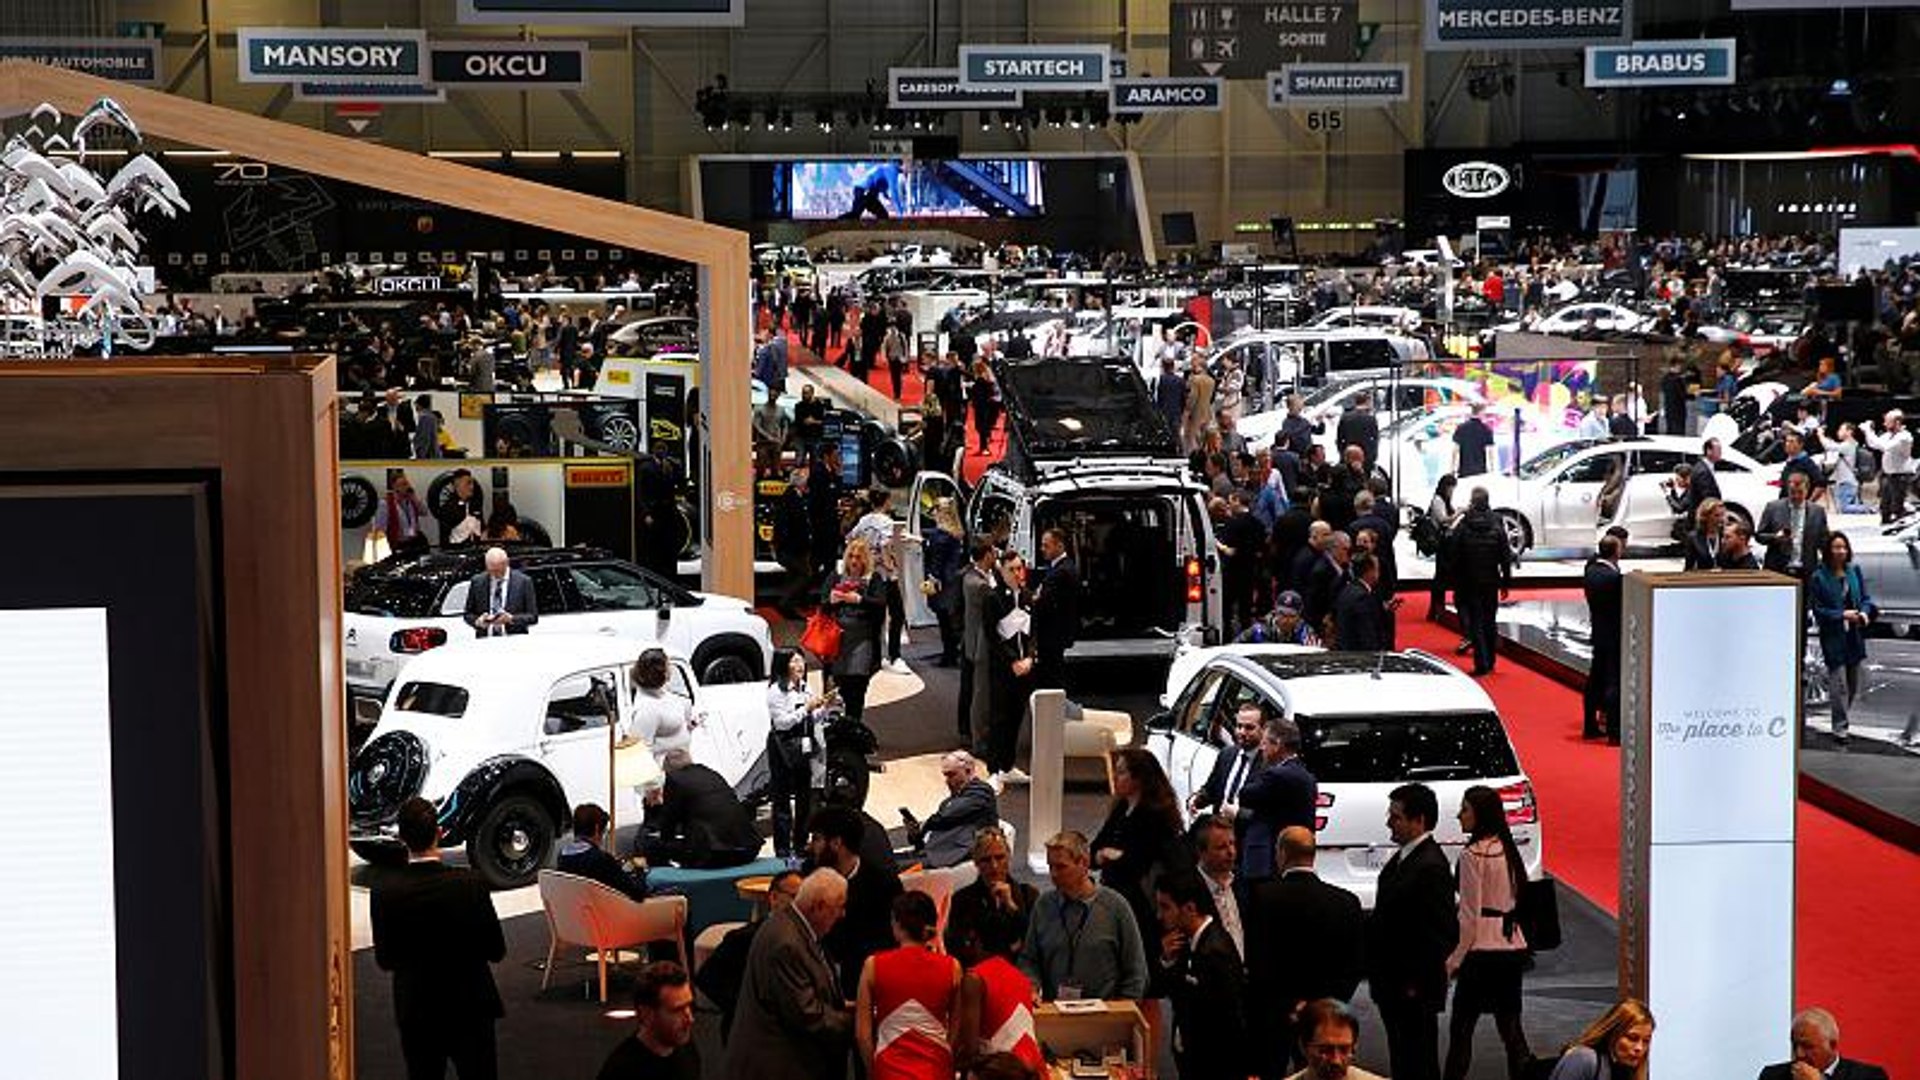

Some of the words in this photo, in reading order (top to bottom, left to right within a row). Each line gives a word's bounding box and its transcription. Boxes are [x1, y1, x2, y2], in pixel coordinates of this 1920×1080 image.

[1264, 7, 1326, 23] HALLE
[1331, 7, 1342, 23] 7
[1440, 7, 1621, 28] MERCEDES-BENZ
[1278, 32, 1327, 47] SORTIE
[51, 56, 145, 69] AUTOMOBILE
[263, 45, 403, 67] MANSORY
[1615, 52, 1706, 73] BRABUS
[465, 55, 547, 76] OKCU
[984, 60, 1084, 76] STARTECH
[1295, 76, 1398, 90] SHARE2DRIVE
[1127, 87, 1207, 103] ARAMCO
[1307, 111, 1342, 130] 615
[212, 163, 268, 179] 70
[1682, 720, 1743, 742] place
[1767, 716, 1787, 738] C
